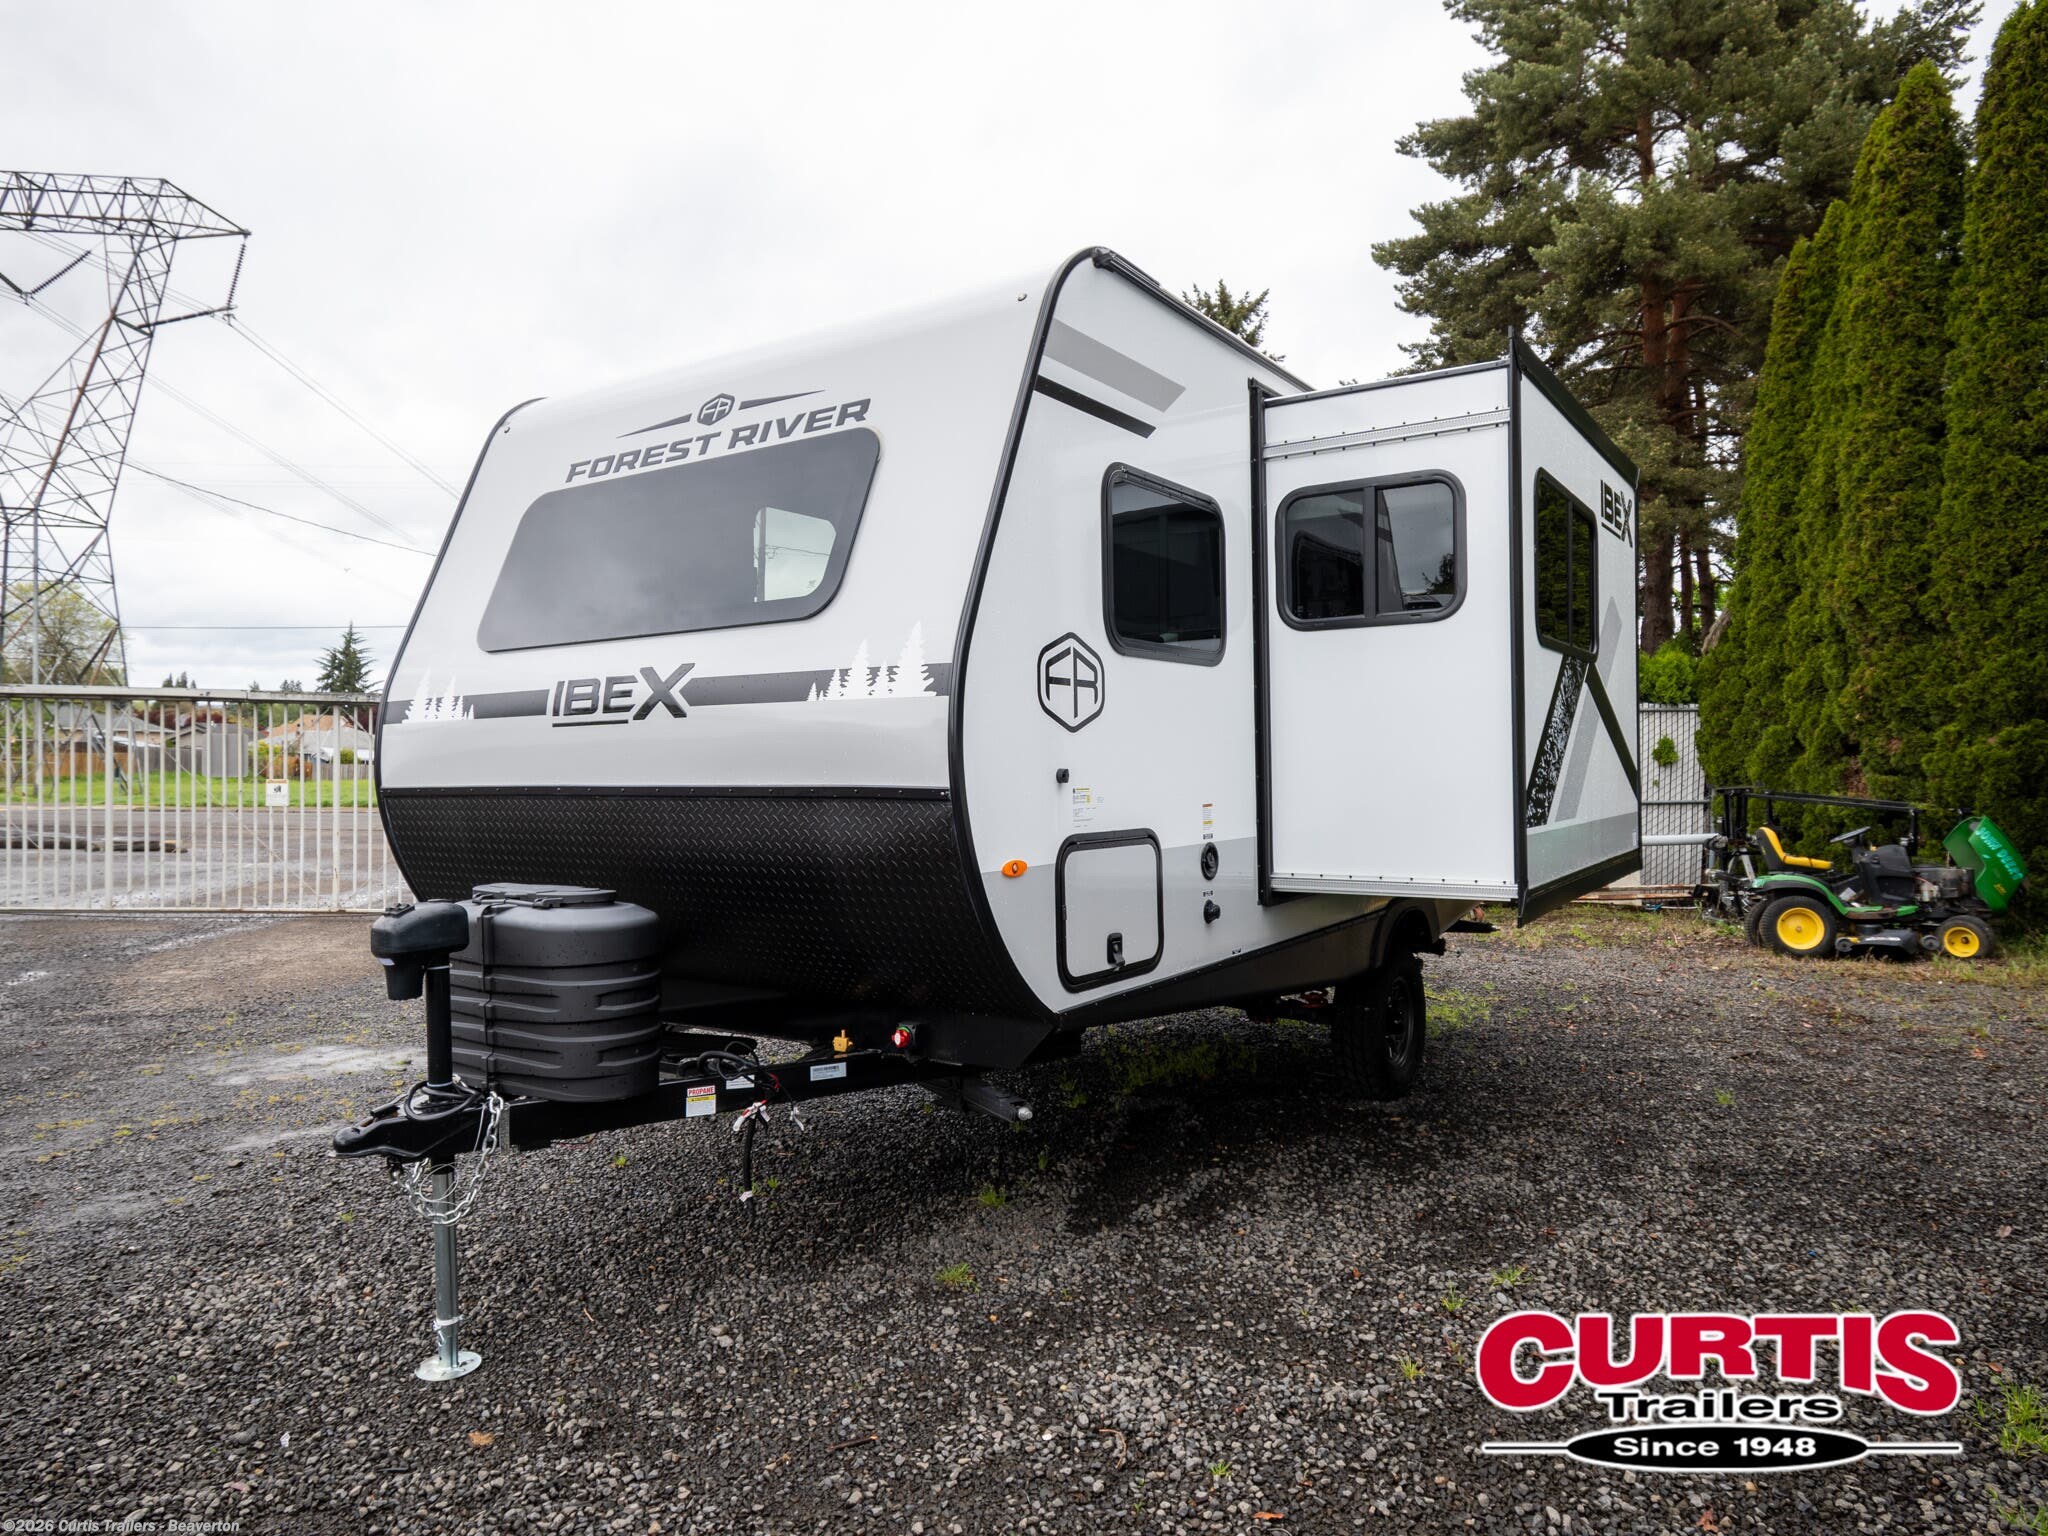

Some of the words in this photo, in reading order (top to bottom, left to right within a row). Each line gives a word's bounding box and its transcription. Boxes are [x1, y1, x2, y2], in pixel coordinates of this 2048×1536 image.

[565, 431, 722, 484] FOREST
[727, 398, 871, 450] RIVER
[1600, 479, 1633, 549] IBEX
[552, 662, 696, 721] IBEX
[1975, 827, 2002, 850] JOHN
[688, 1086, 714, 1095] PROPANE
